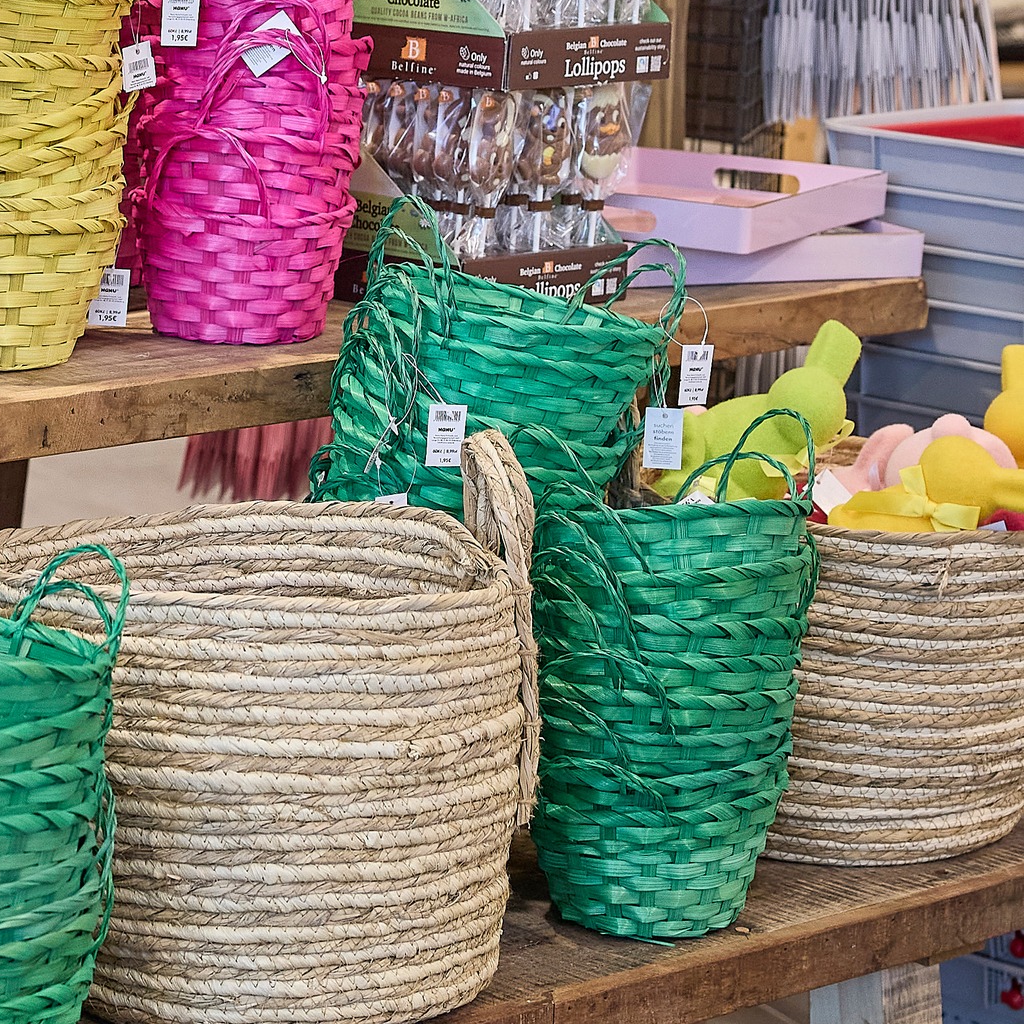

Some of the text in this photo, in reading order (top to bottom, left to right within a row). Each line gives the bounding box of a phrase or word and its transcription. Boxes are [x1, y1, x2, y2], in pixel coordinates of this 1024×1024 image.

[371, 6, 469, 23] QUALITY COCOA BEANS FROM W-AFRICA
[171, 34, 188, 42] 1,95€
[565, 41, 587, 51] Belgian
[599, 38, 628, 48] Chocolate
[471, 52, 488, 64] Only
[530, 48, 544, 59] Only
[391, 60, 434, 75] Belfine
[474, 69, 492, 77] Belgium
[564, 57, 626, 81] Lollipops
[519, 266, 542, 276] Belgian
[554, 262, 583, 273] Chocolate
[98, 314, 118, 322] 1,95€
